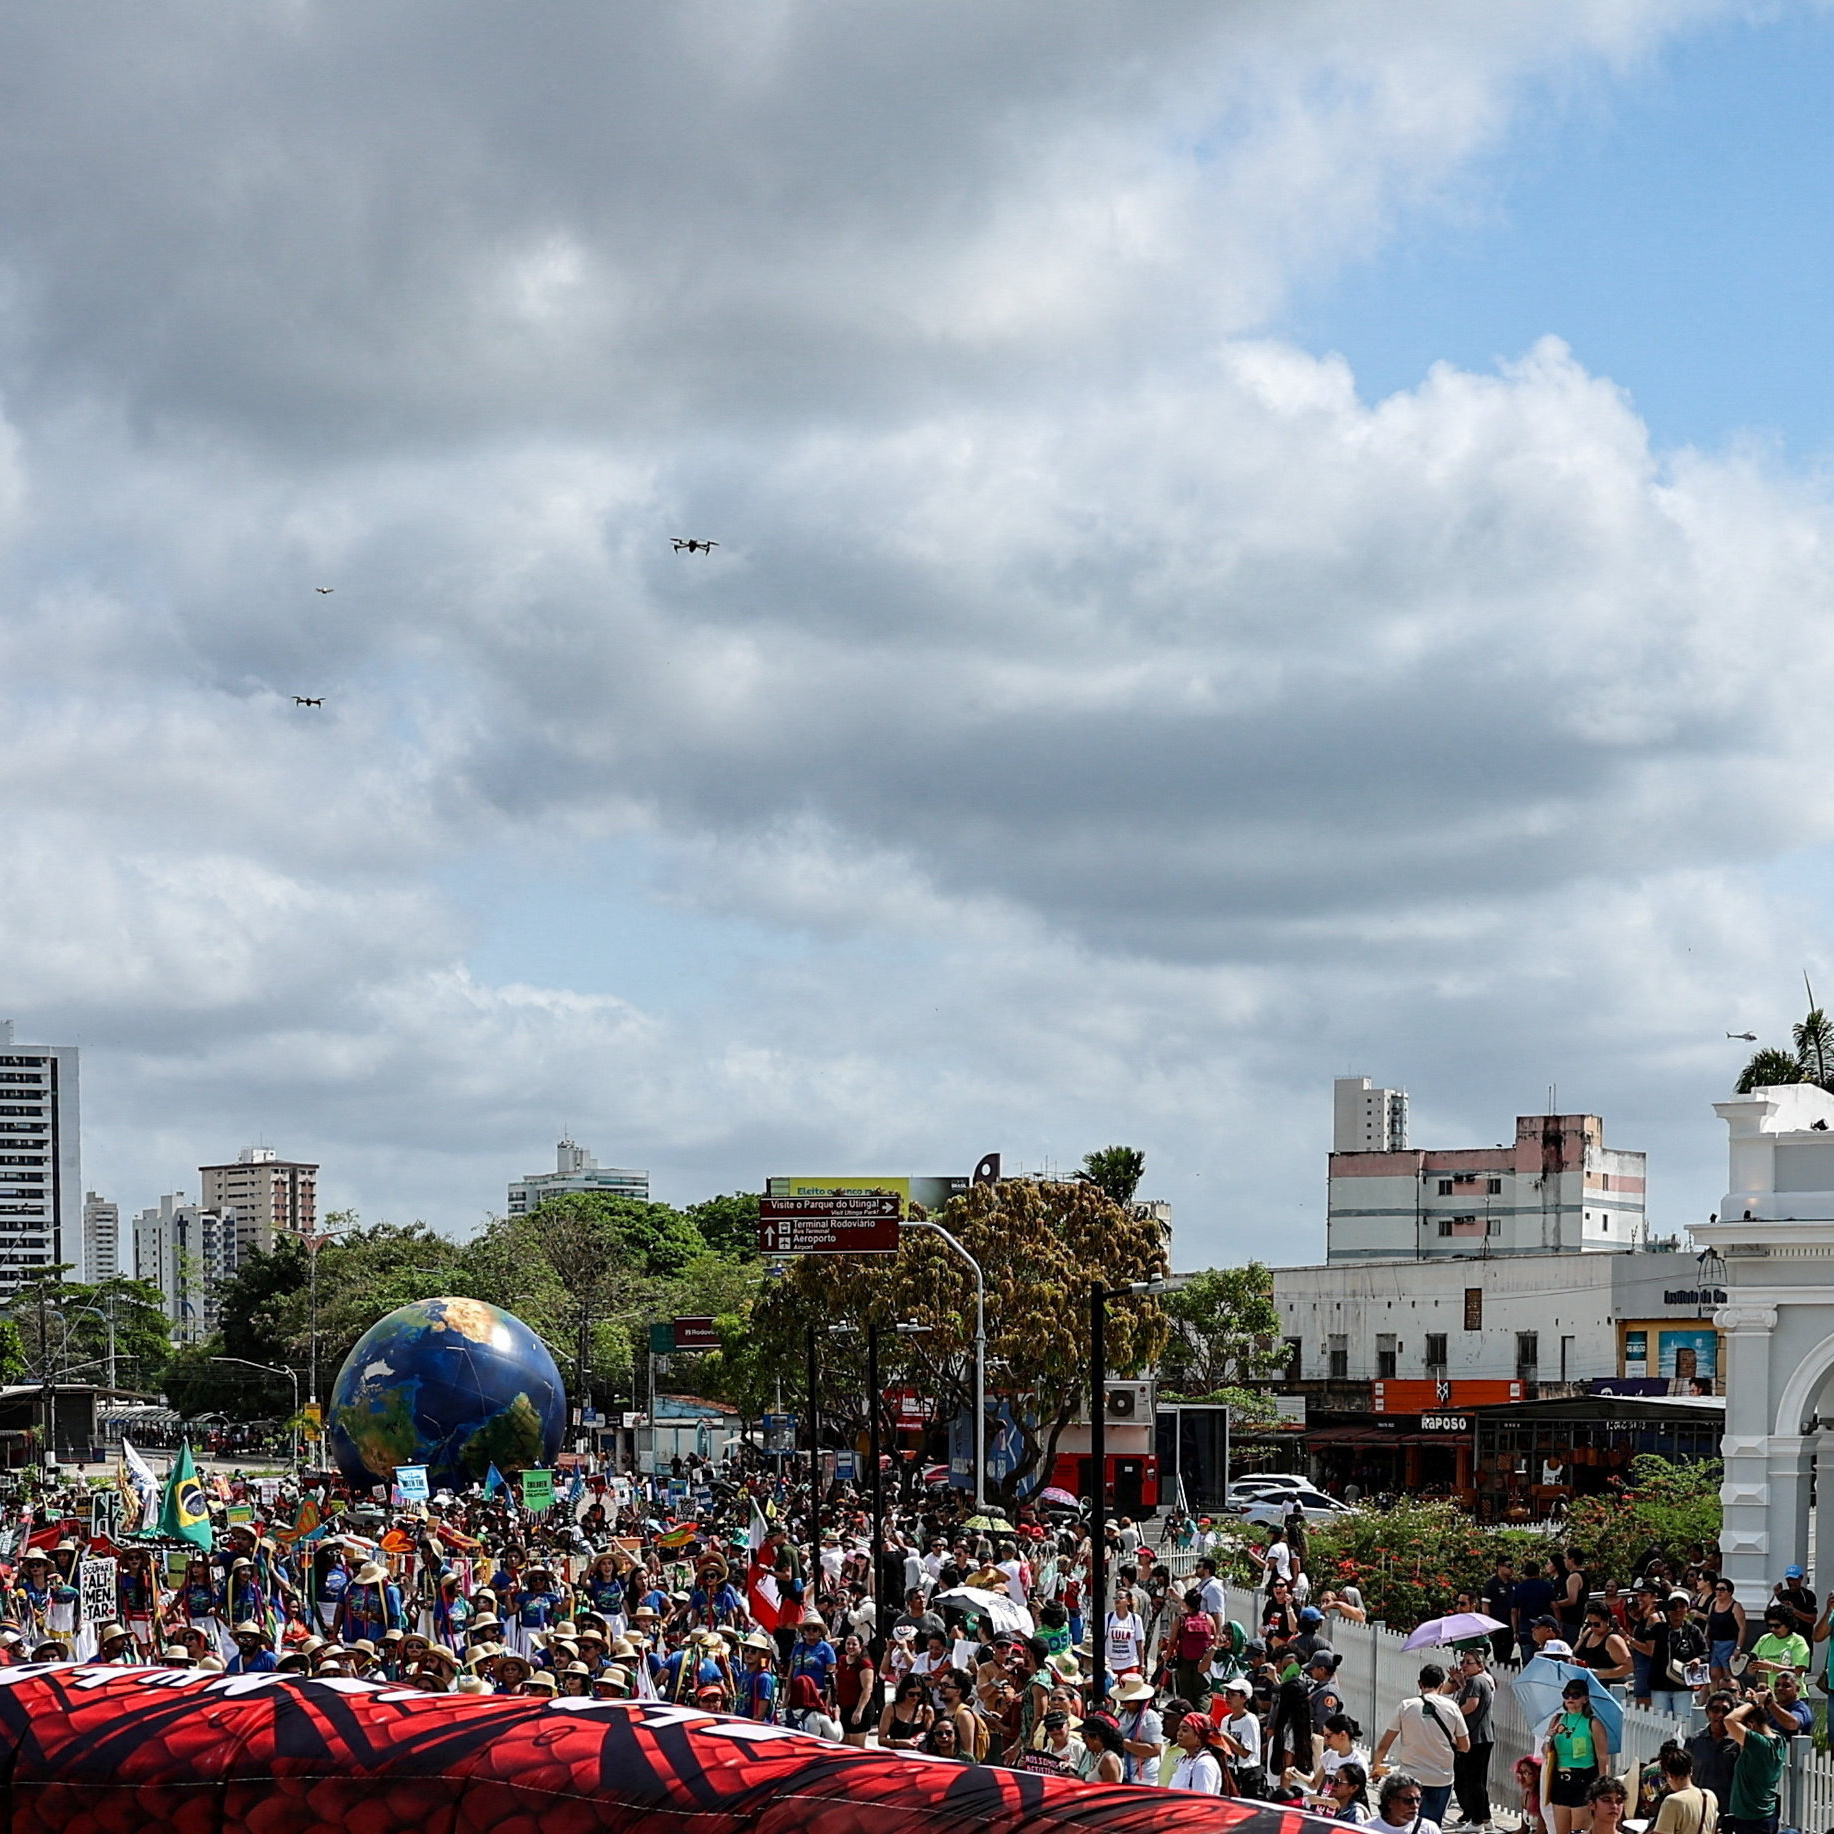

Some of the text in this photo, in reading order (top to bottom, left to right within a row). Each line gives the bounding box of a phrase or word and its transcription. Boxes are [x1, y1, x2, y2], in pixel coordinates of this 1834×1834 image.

[771, 1199, 879, 1211] Visite o Parque do Utinga!
[793, 1219, 876, 1229] Terminal Rodoviário
[793, 1234, 836, 1244] Aeroporto
[88, 1573, 107, 1588] ALI
[87, 1603, 109, 1620] TAR
[1111, 1630, 1131, 1640] LULA
